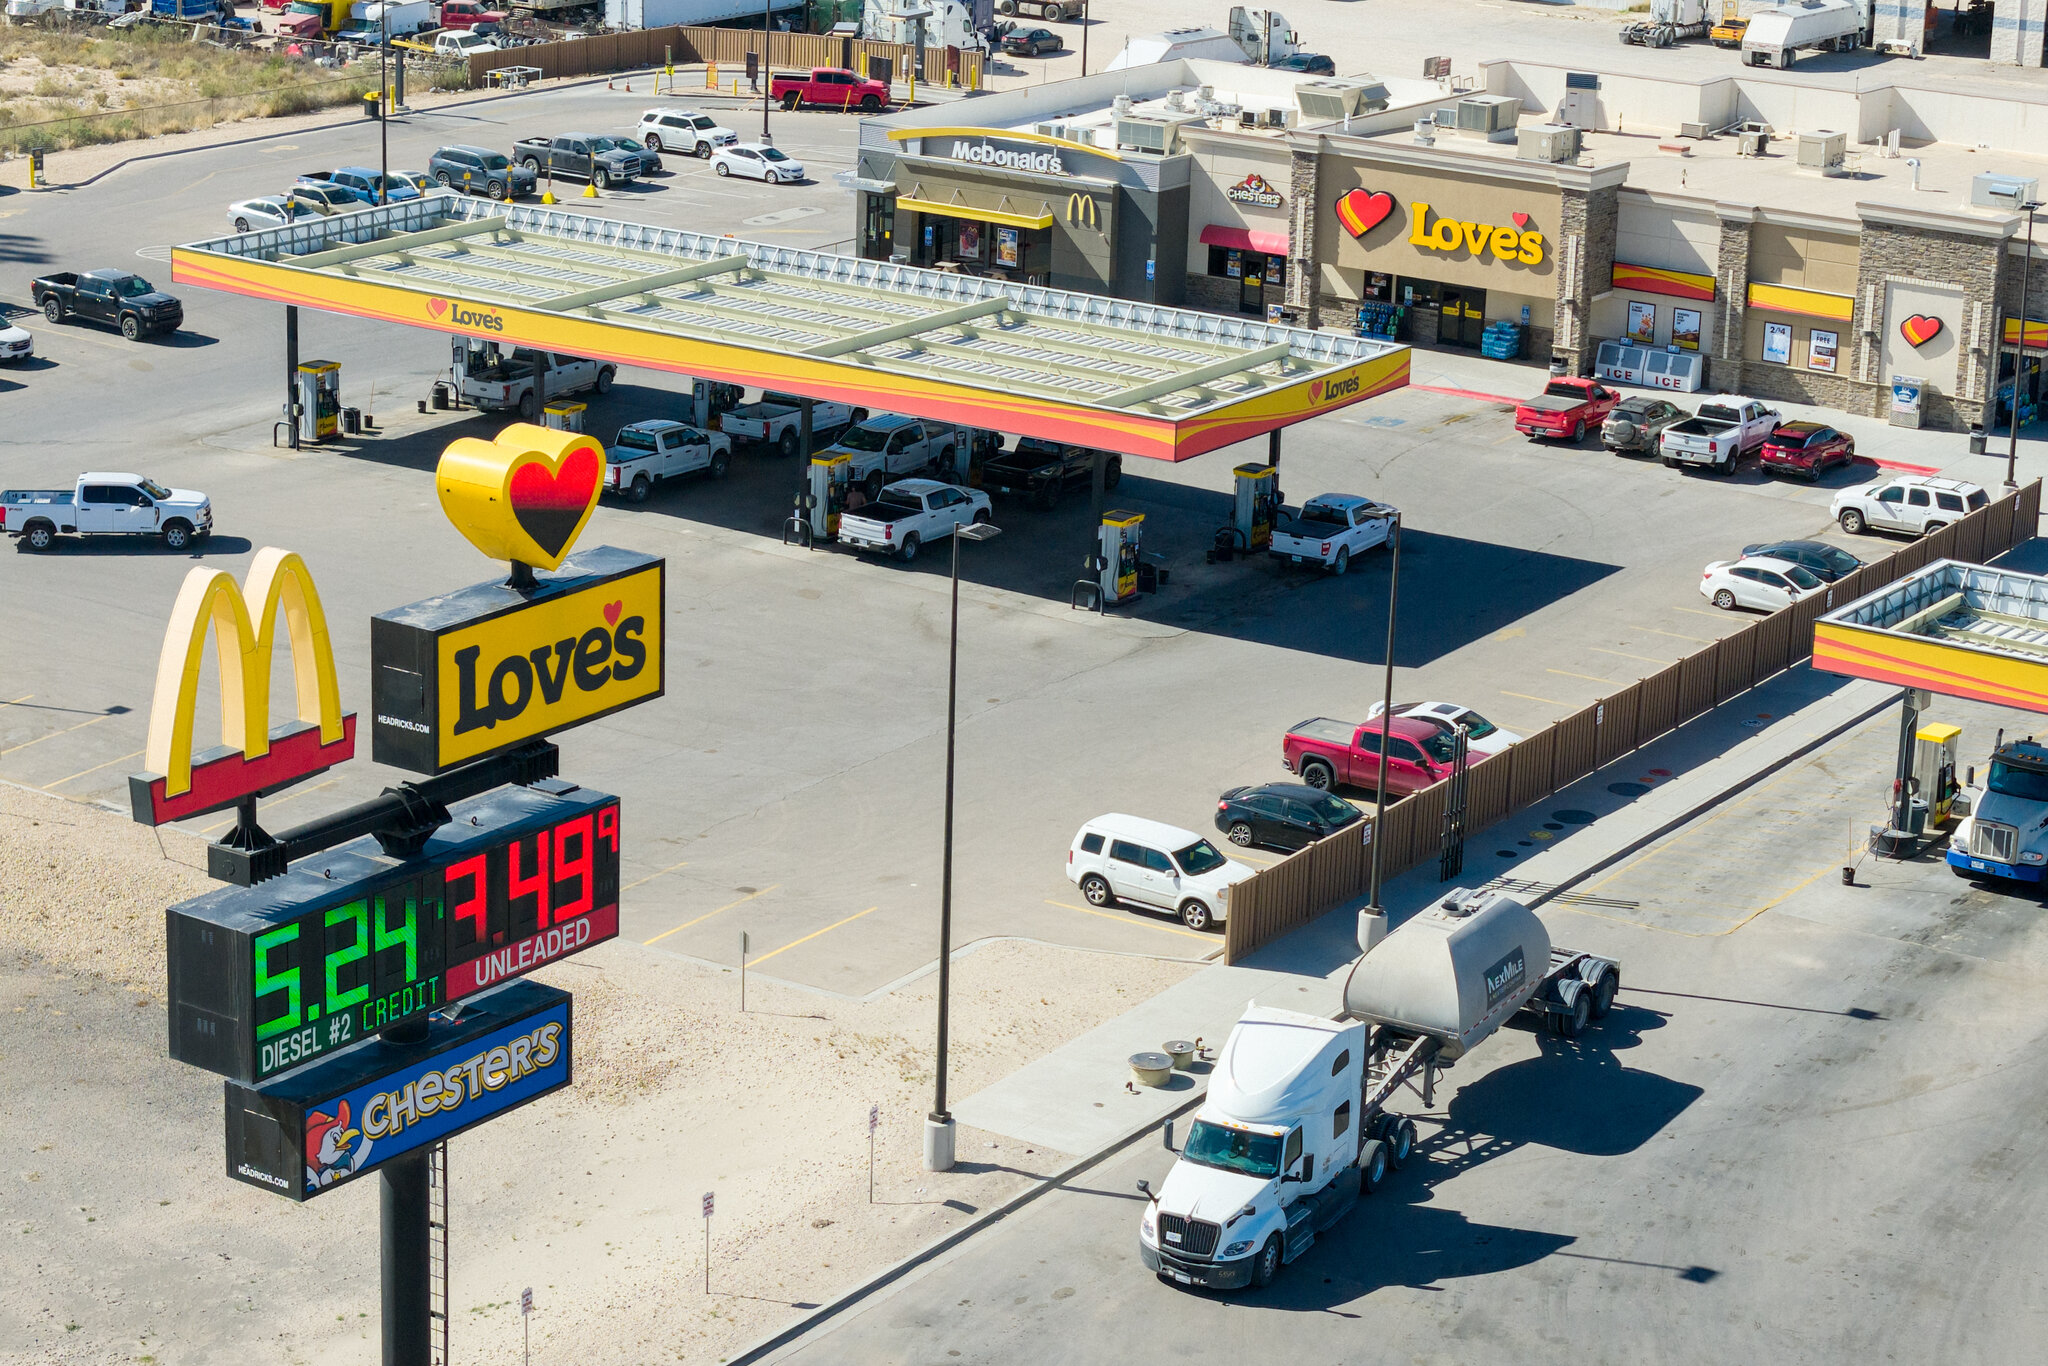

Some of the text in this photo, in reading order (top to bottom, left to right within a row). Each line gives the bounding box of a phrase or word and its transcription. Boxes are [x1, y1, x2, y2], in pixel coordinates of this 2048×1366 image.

[951, 140, 1063, 174] McDonald's
[1605, 367, 1633, 381] ICE
[1654, 375, 1681, 389] ICE
[377, 714, 430, 735] HEADRICKS.COM
[475, 917, 591, 986] UNLEADED
[362, 976, 439, 1031] CREDIT
[262, 1012, 351, 1073] DIESEL #2
[237, 1163, 289, 1190] HEADRICKS.COM
